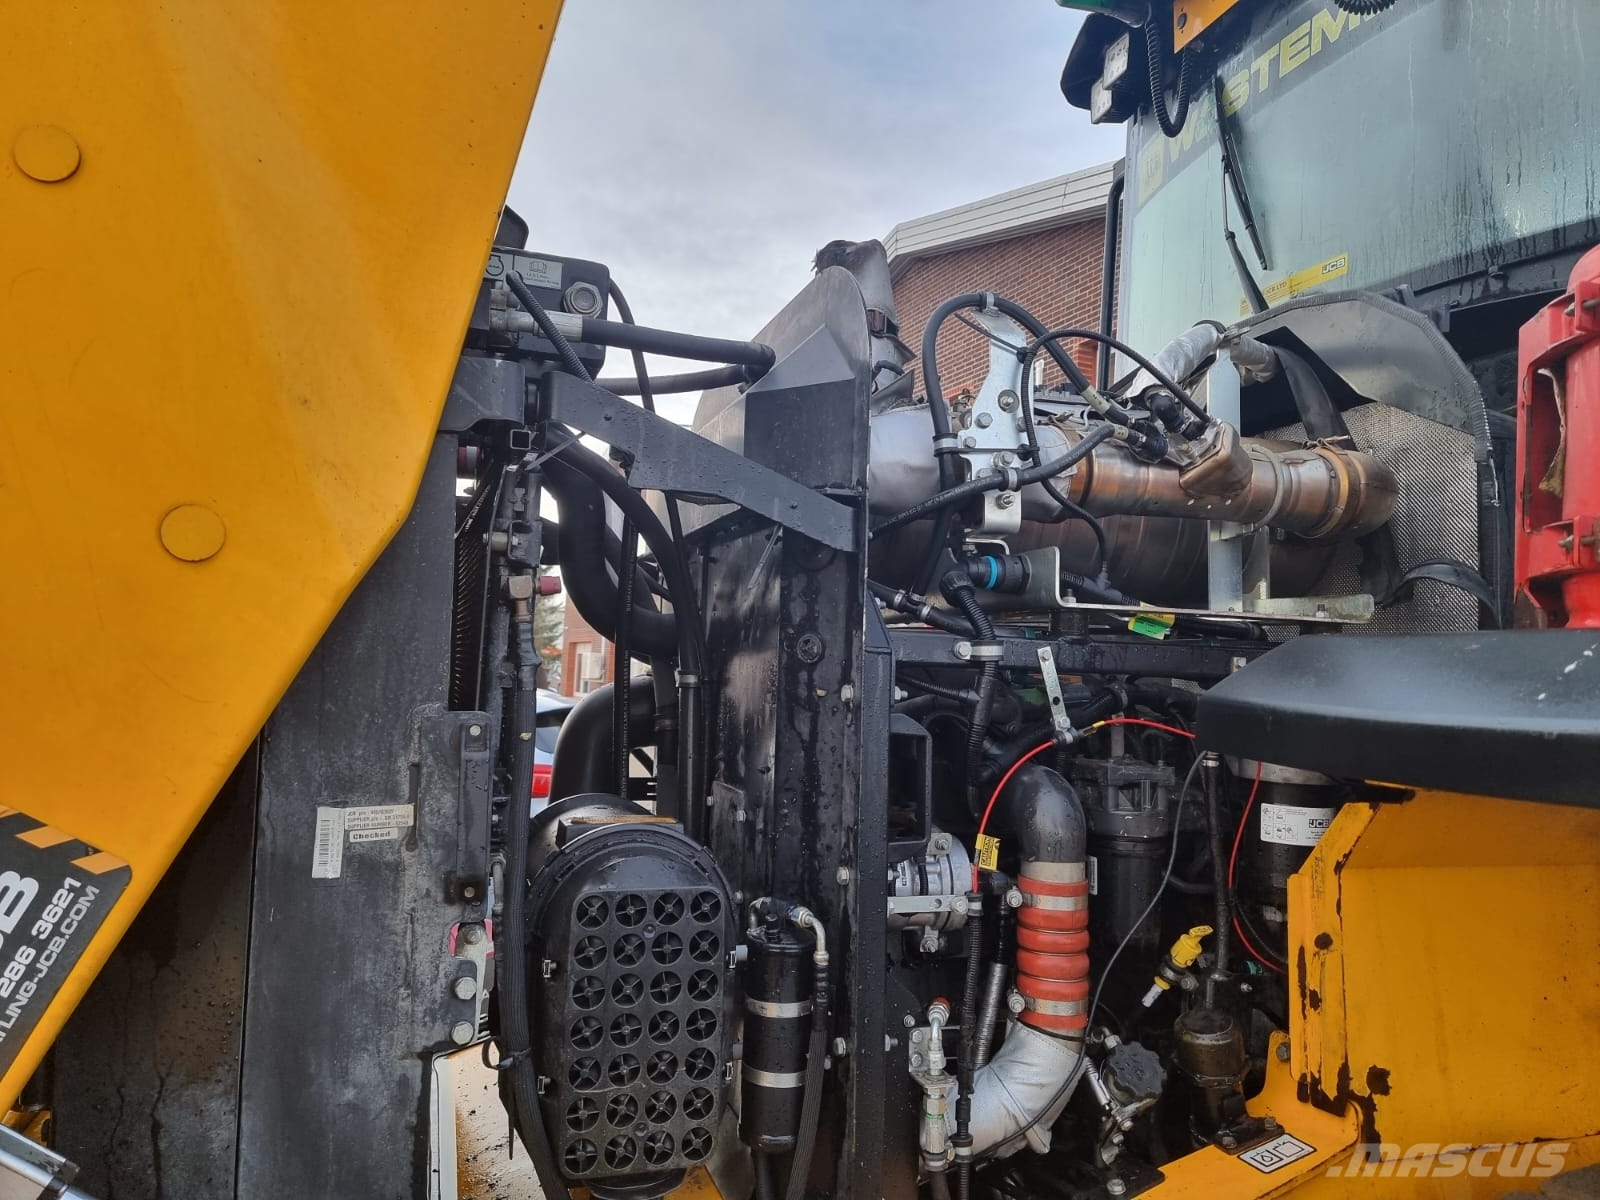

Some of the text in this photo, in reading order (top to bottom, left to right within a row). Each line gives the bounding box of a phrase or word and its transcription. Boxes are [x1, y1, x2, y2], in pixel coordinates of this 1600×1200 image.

[1323, 258, 1345, 274] JCB
[353, 831, 391, 840] Checked
[0, 876, 82, 998] 286 3621
[0, 885, 100, 1042] LING-JCB.COM
